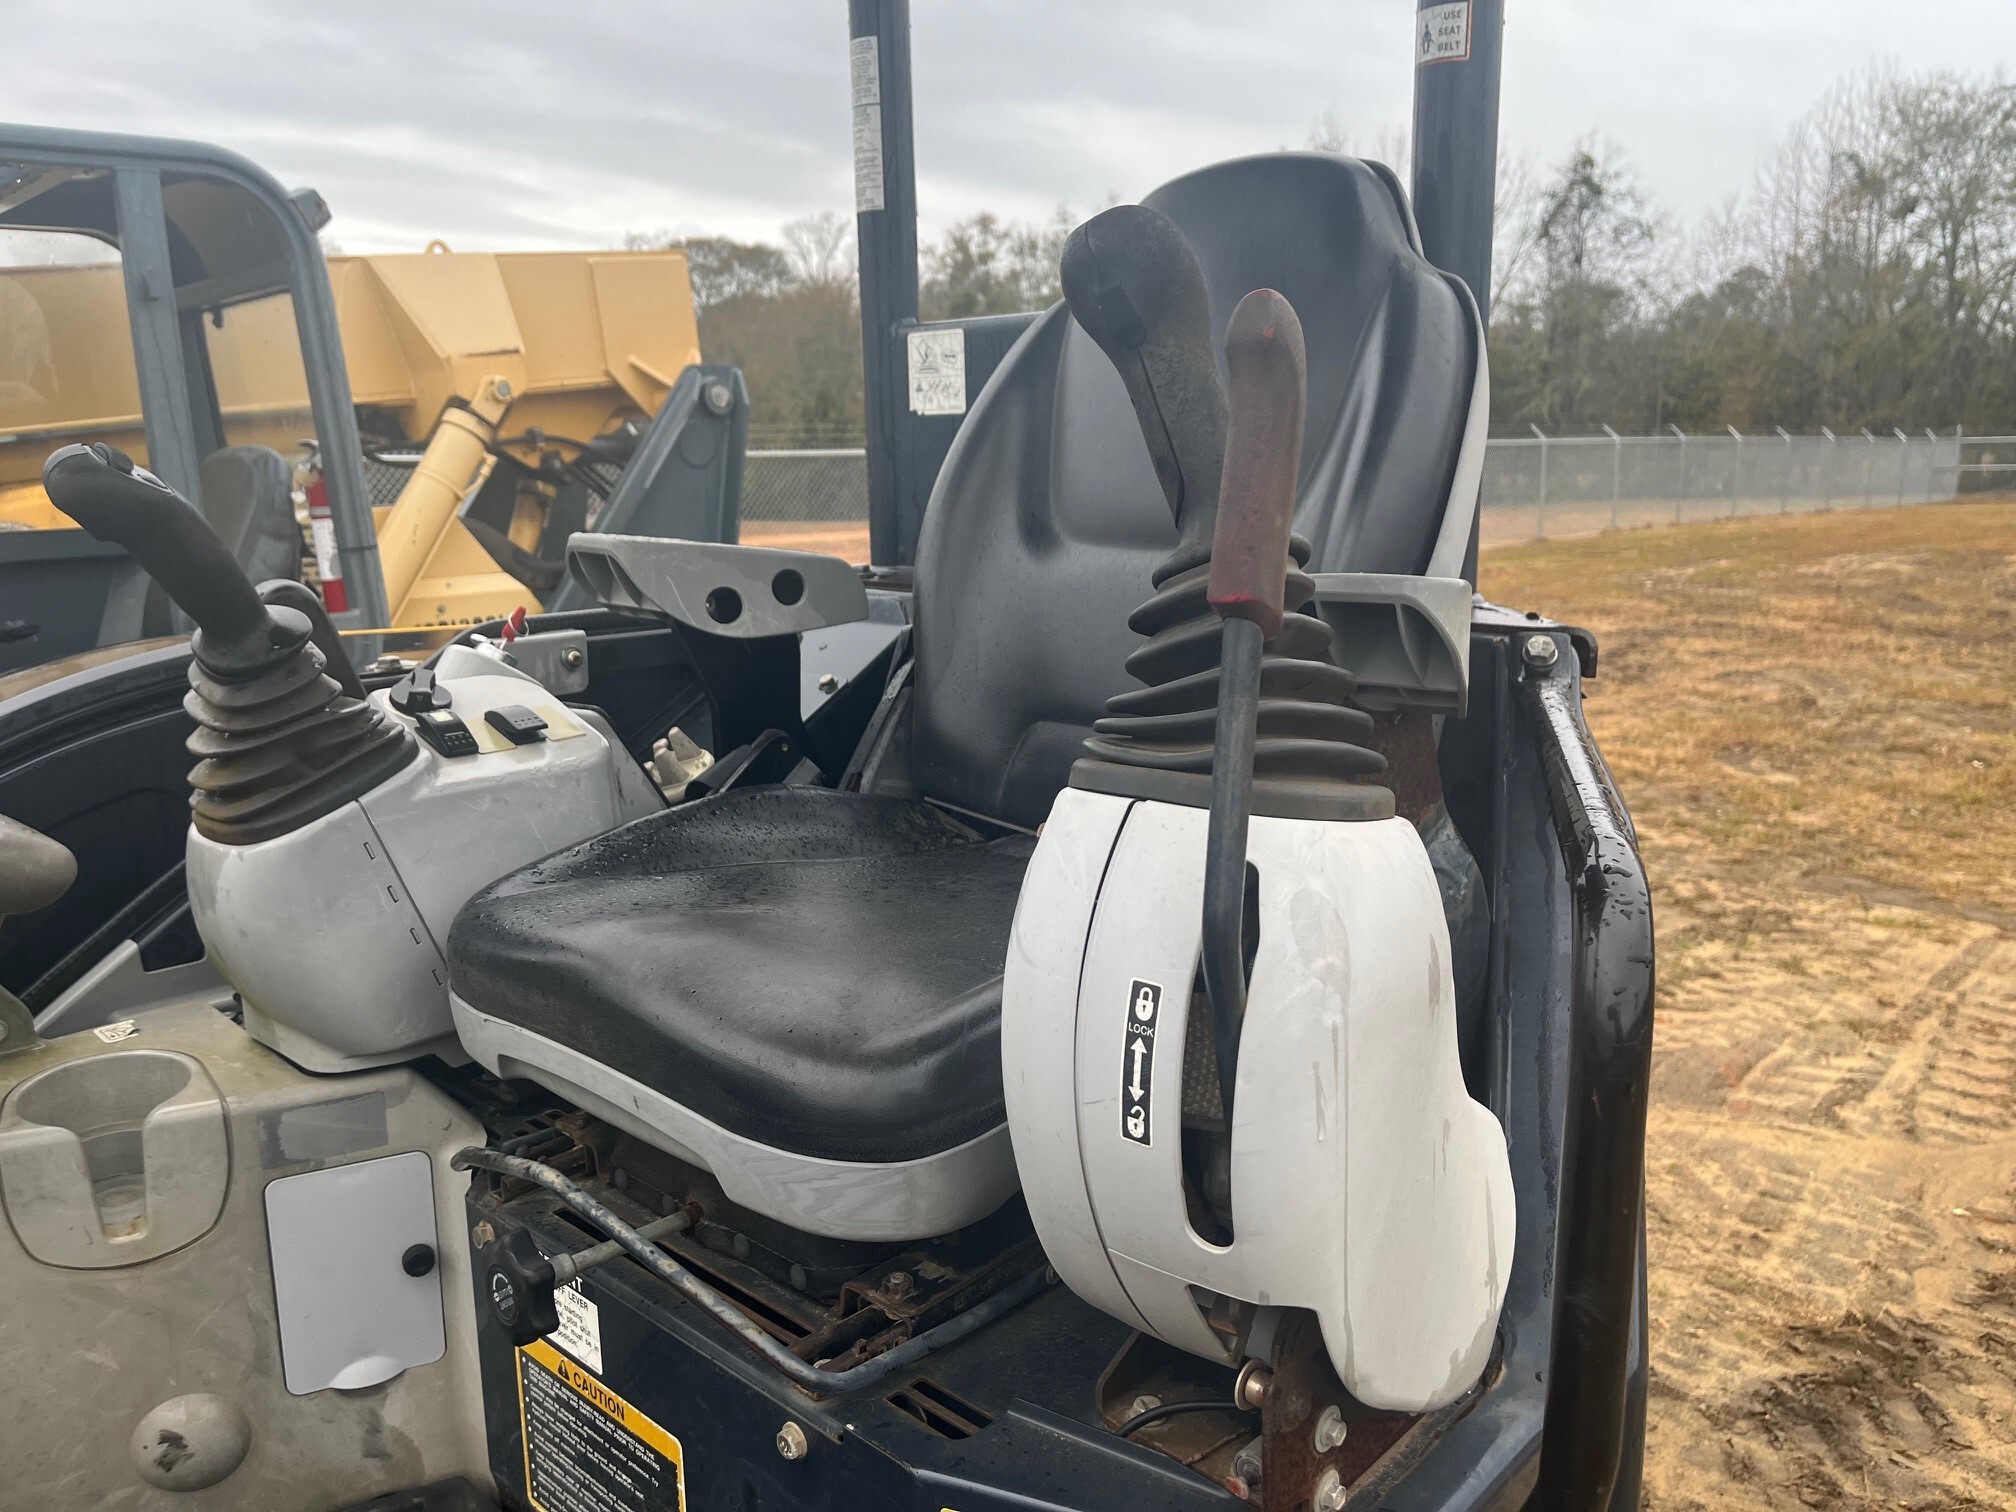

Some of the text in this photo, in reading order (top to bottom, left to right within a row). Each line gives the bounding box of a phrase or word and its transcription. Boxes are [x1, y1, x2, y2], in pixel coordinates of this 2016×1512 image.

[1444, 9, 1462, 20] USE
[1438, 25, 1461, 37] SEAT
[1438, 41, 1461, 52] BELT
[1128, 1022, 1154, 1037] LOCK
[568, 1291, 589, 1312] LEVER
[564, 1305, 583, 1323] starting
[573, 1371, 626, 1421] CAUTION
